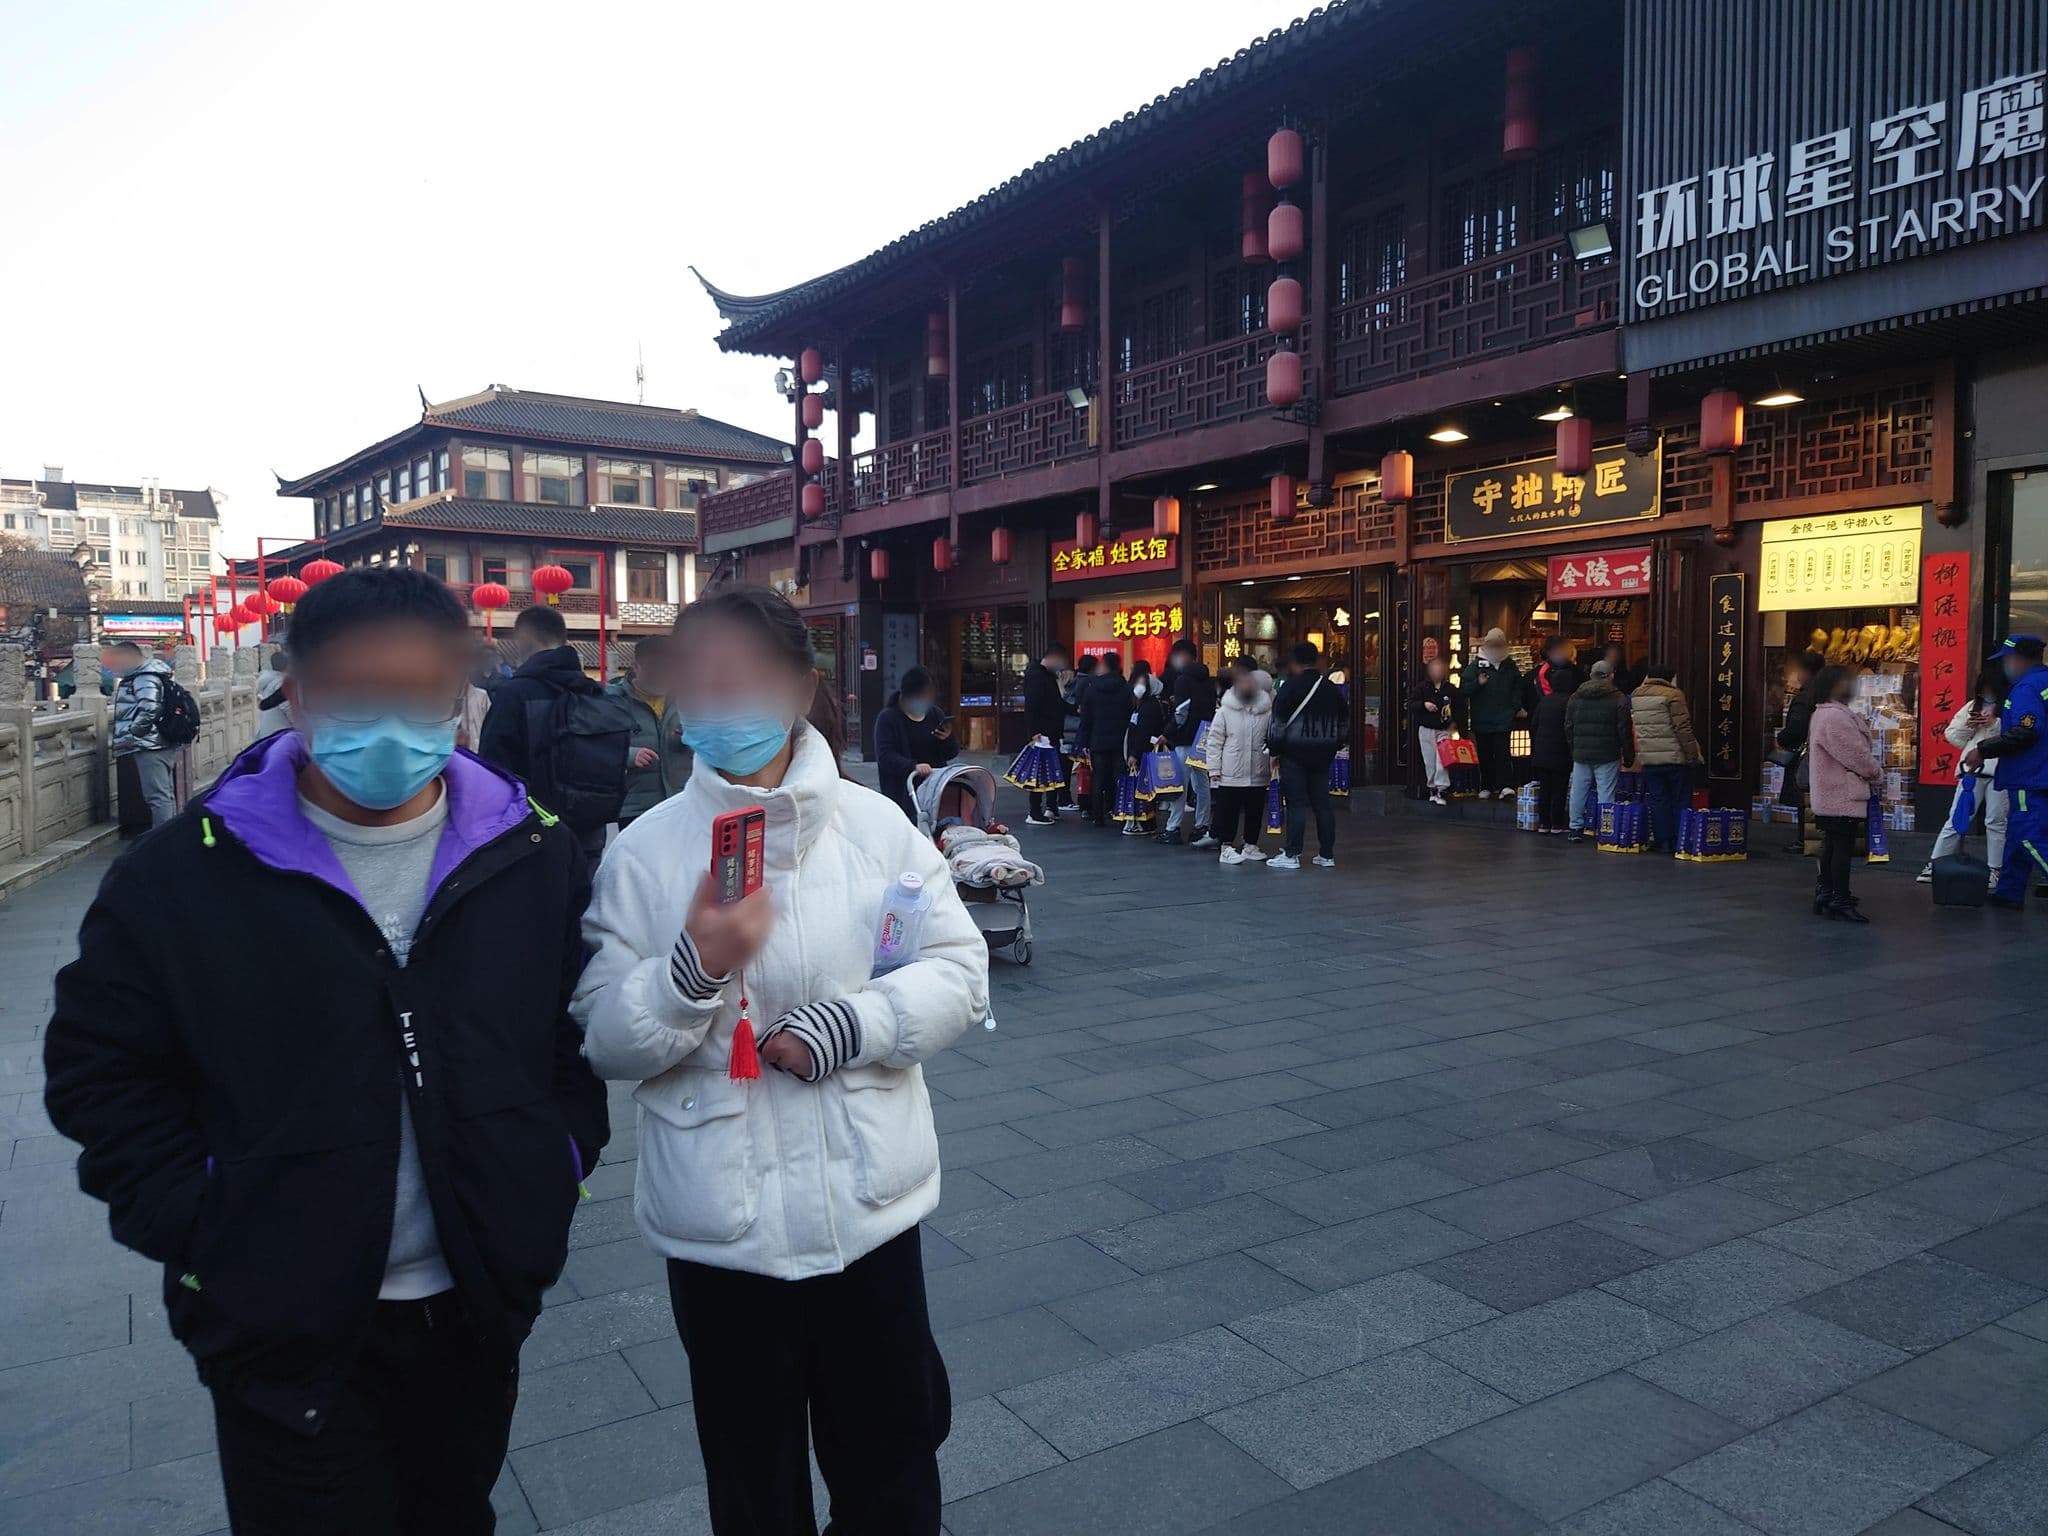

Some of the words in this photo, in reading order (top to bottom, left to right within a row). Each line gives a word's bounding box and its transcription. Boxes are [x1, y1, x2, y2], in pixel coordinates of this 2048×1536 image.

[1636, 69, 2047, 259] 环球星空魔
[1636, 240, 1809, 308] GLOBAL
[1826, 176, 2046, 262] STARRY
[1053, 544, 1105, 572] 全家福
[1110, 537, 1168, 565] 姓氏馆
[1790, 520, 1838, 534] 金陵一绝
[1843, 514, 1894, 528] 守拙八艺
